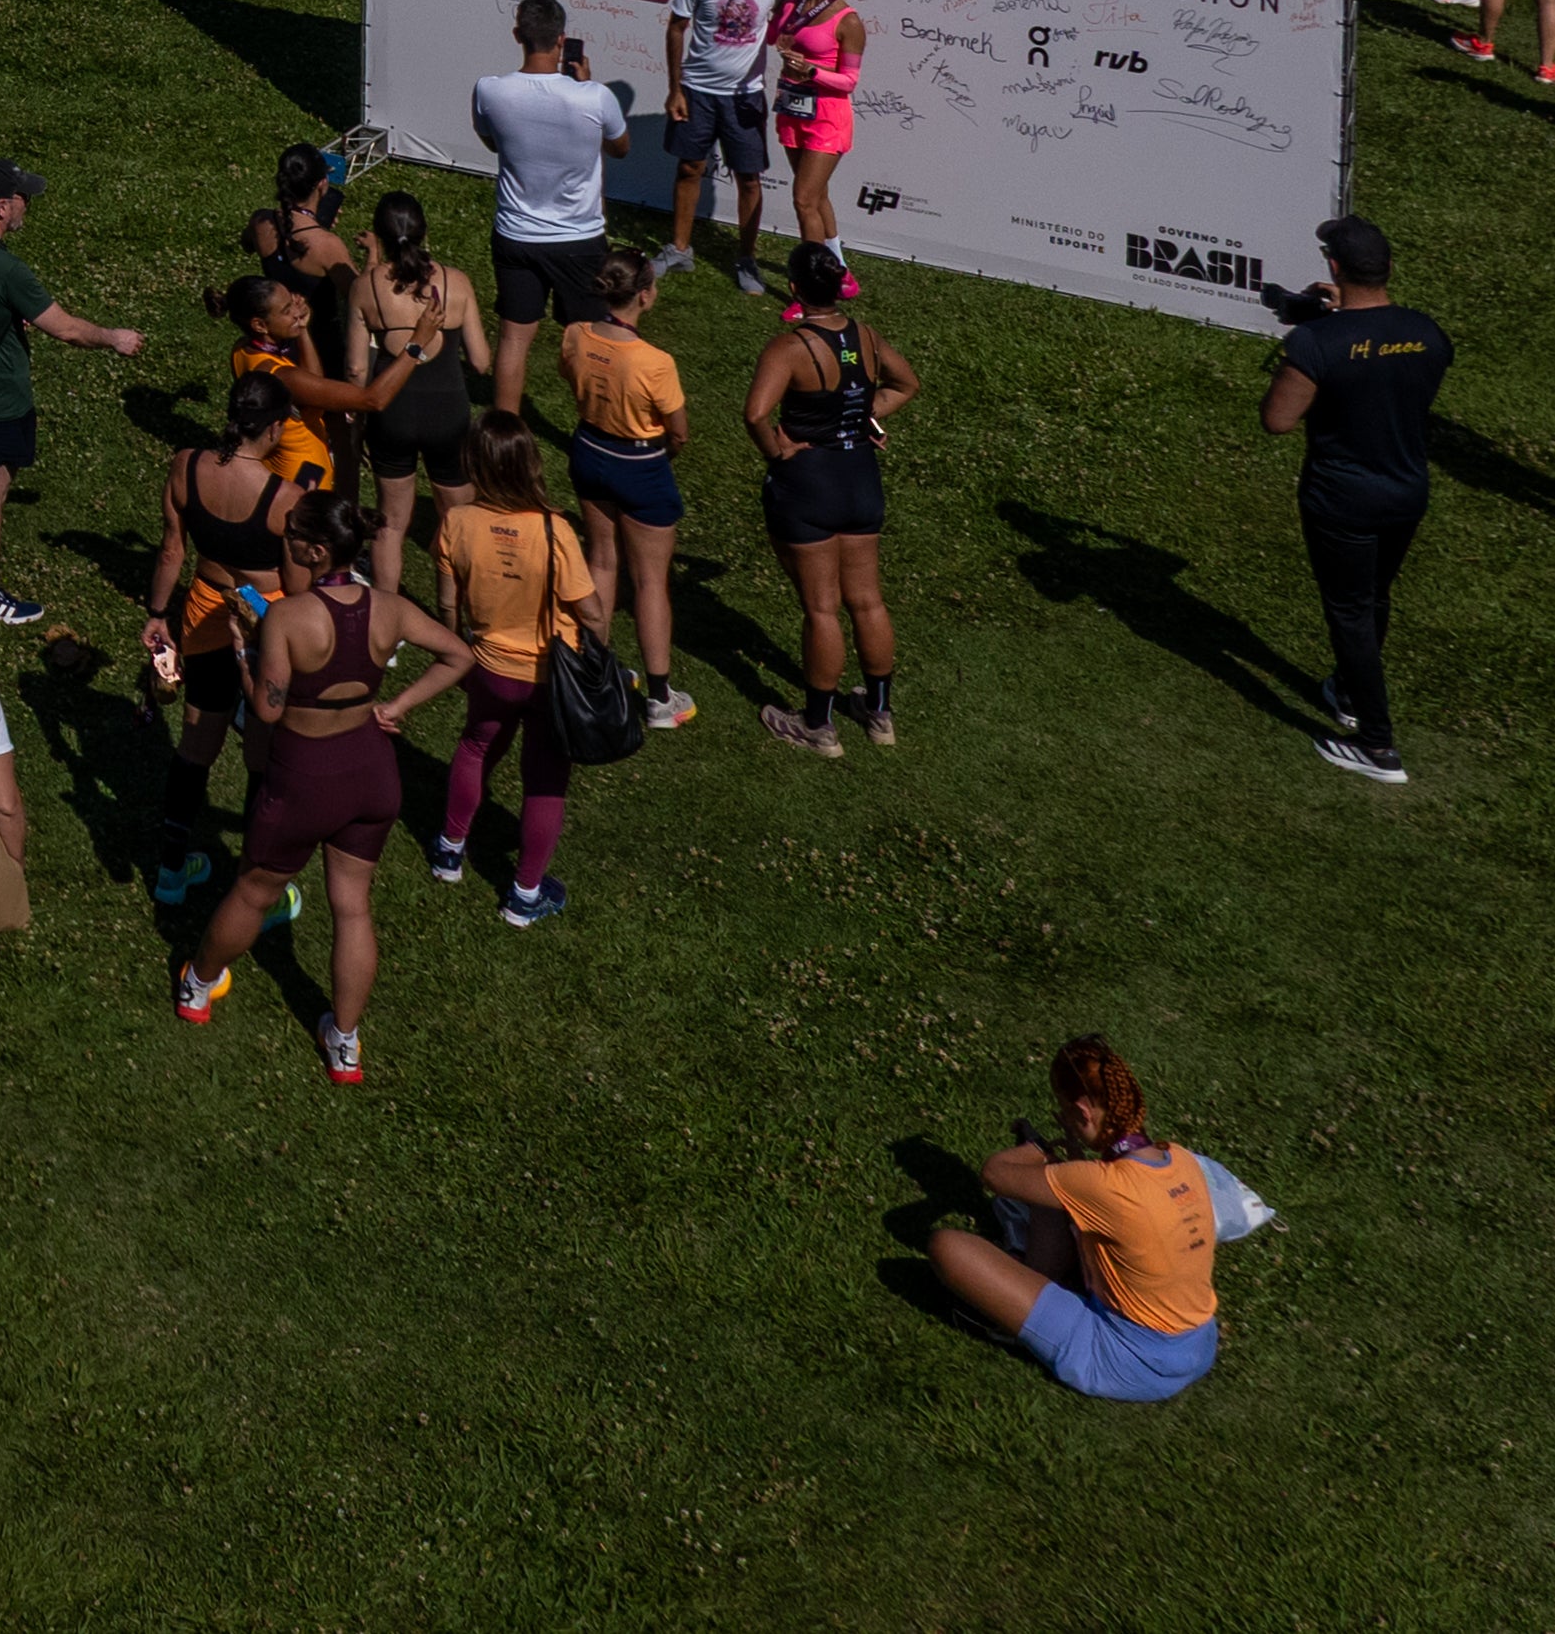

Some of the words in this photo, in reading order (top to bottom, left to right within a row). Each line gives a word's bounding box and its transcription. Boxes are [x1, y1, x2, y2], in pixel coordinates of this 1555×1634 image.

[1010, 215, 1084, 239] MINISTÉRIO
[1087, 229, 1106, 242] DO
[1158, 225, 1219, 245] GOVERNO
[1225, 238, 1243, 249] DO
[1049, 235, 1106, 254] ESPORTE
[1125, 231, 1264, 293] BRASIL
[1148, 276, 1172, 288] LADO
[1190, 284, 1215, 296] POVO
[1217, 289, 1261, 305] BRASILEIR
[1349, 339, 1373, 360] 14
